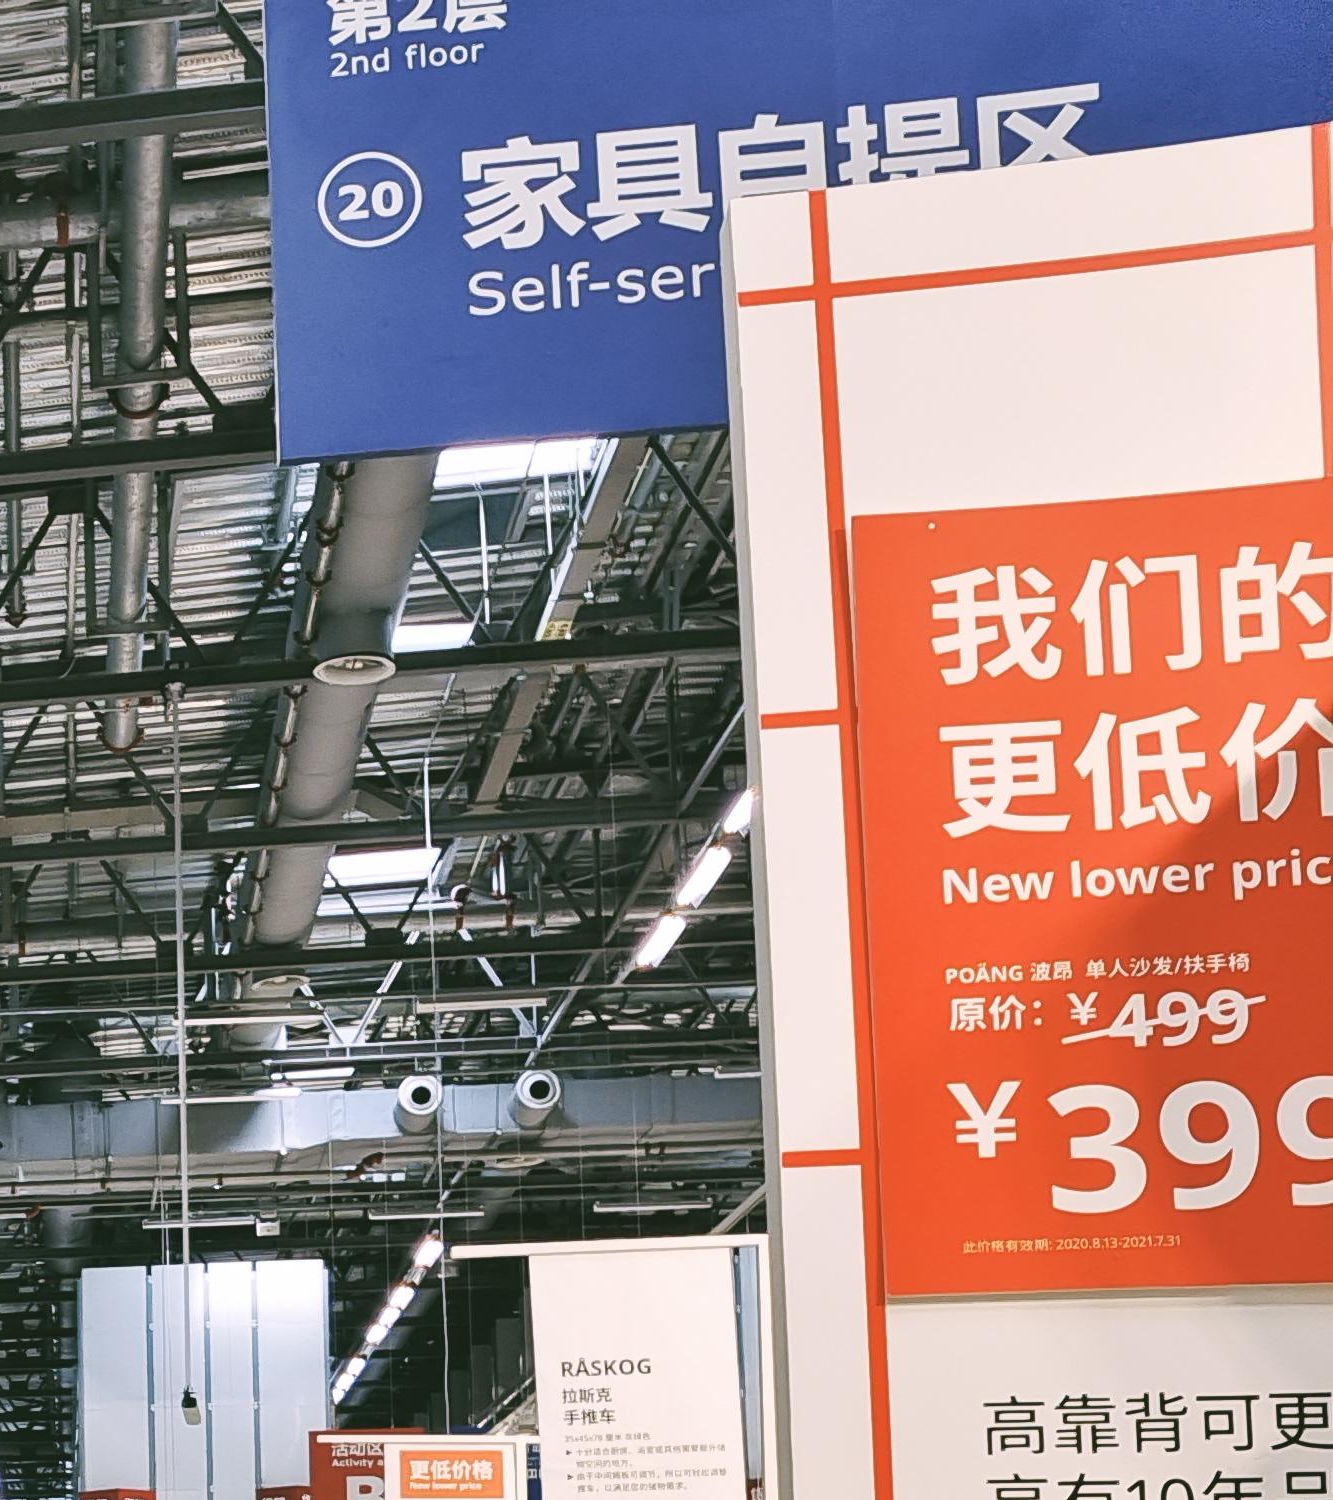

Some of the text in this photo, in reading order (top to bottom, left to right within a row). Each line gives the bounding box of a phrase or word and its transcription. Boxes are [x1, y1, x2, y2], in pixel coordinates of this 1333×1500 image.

[330, 38, 484, 78] 2nd floor
[338, 183, 404, 221] 20
[930, 541, 1333, 686] 我们的
[939, 697, 1333, 838] 更低价
[943, 867, 1054, 906] New
[1070, 859, 1214, 898] lower
[945, 952, 1251, 985] POÄNG 波昂 单人沙发/扶手椅
[561, 1357, 652, 1378] RÅSKOG
[562, 1387, 613, 1404] 拉斯克
[564, 1408, 617, 1426] 手推车
[983, 1392, 1333, 1456] 高靠背可更
[332, 1458, 374, 1469] Activity
[409, 1459, 493, 1481] 更低价格
